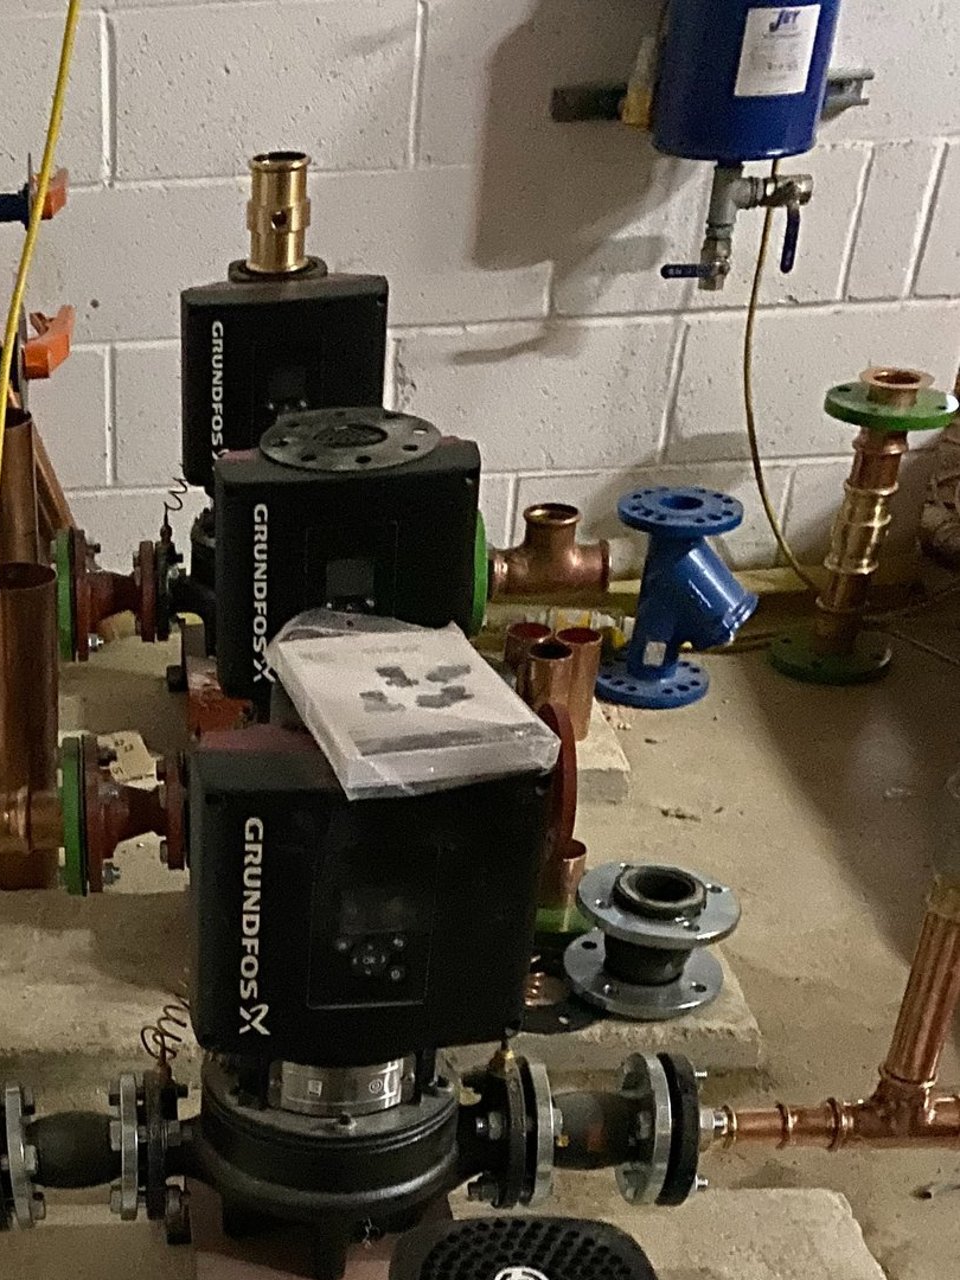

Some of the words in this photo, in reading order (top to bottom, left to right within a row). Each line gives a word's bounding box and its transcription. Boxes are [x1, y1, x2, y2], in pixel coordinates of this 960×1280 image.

[211, 320, 224, 446] GRUNDFOS
[253, 503, 269, 652] GRUNDFOS
[239, 817, 264, 999] GRUNDFOS
